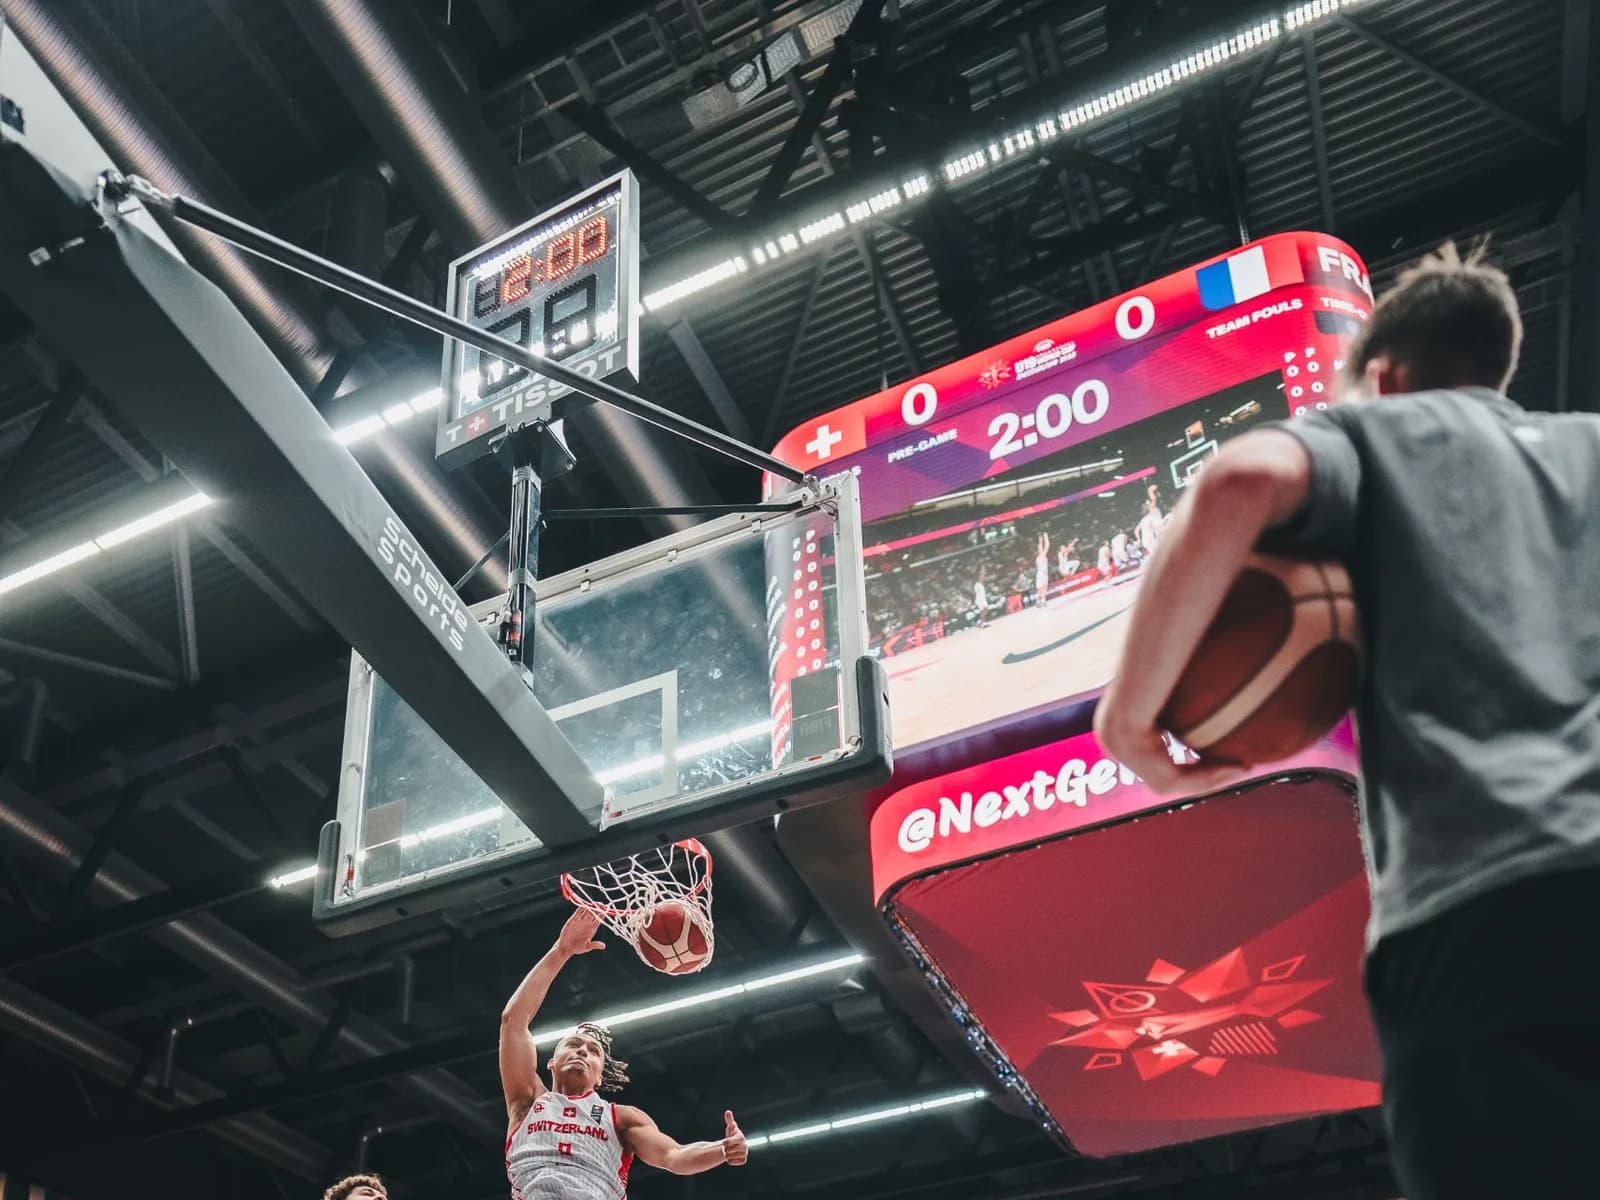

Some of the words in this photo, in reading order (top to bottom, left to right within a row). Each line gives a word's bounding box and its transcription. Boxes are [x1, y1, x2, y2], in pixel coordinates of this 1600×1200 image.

[503, 216, 608, 304] 2:00
[1115, 296, 1155, 340] 0
[1206, 315, 1250, 339] TEAM
[1251, 298, 1304, 323] FOULS
[901, 382, 938, 426] 0
[987, 379, 1110, 461] 2:00
[887, 428, 958, 463] PRE-GAME
